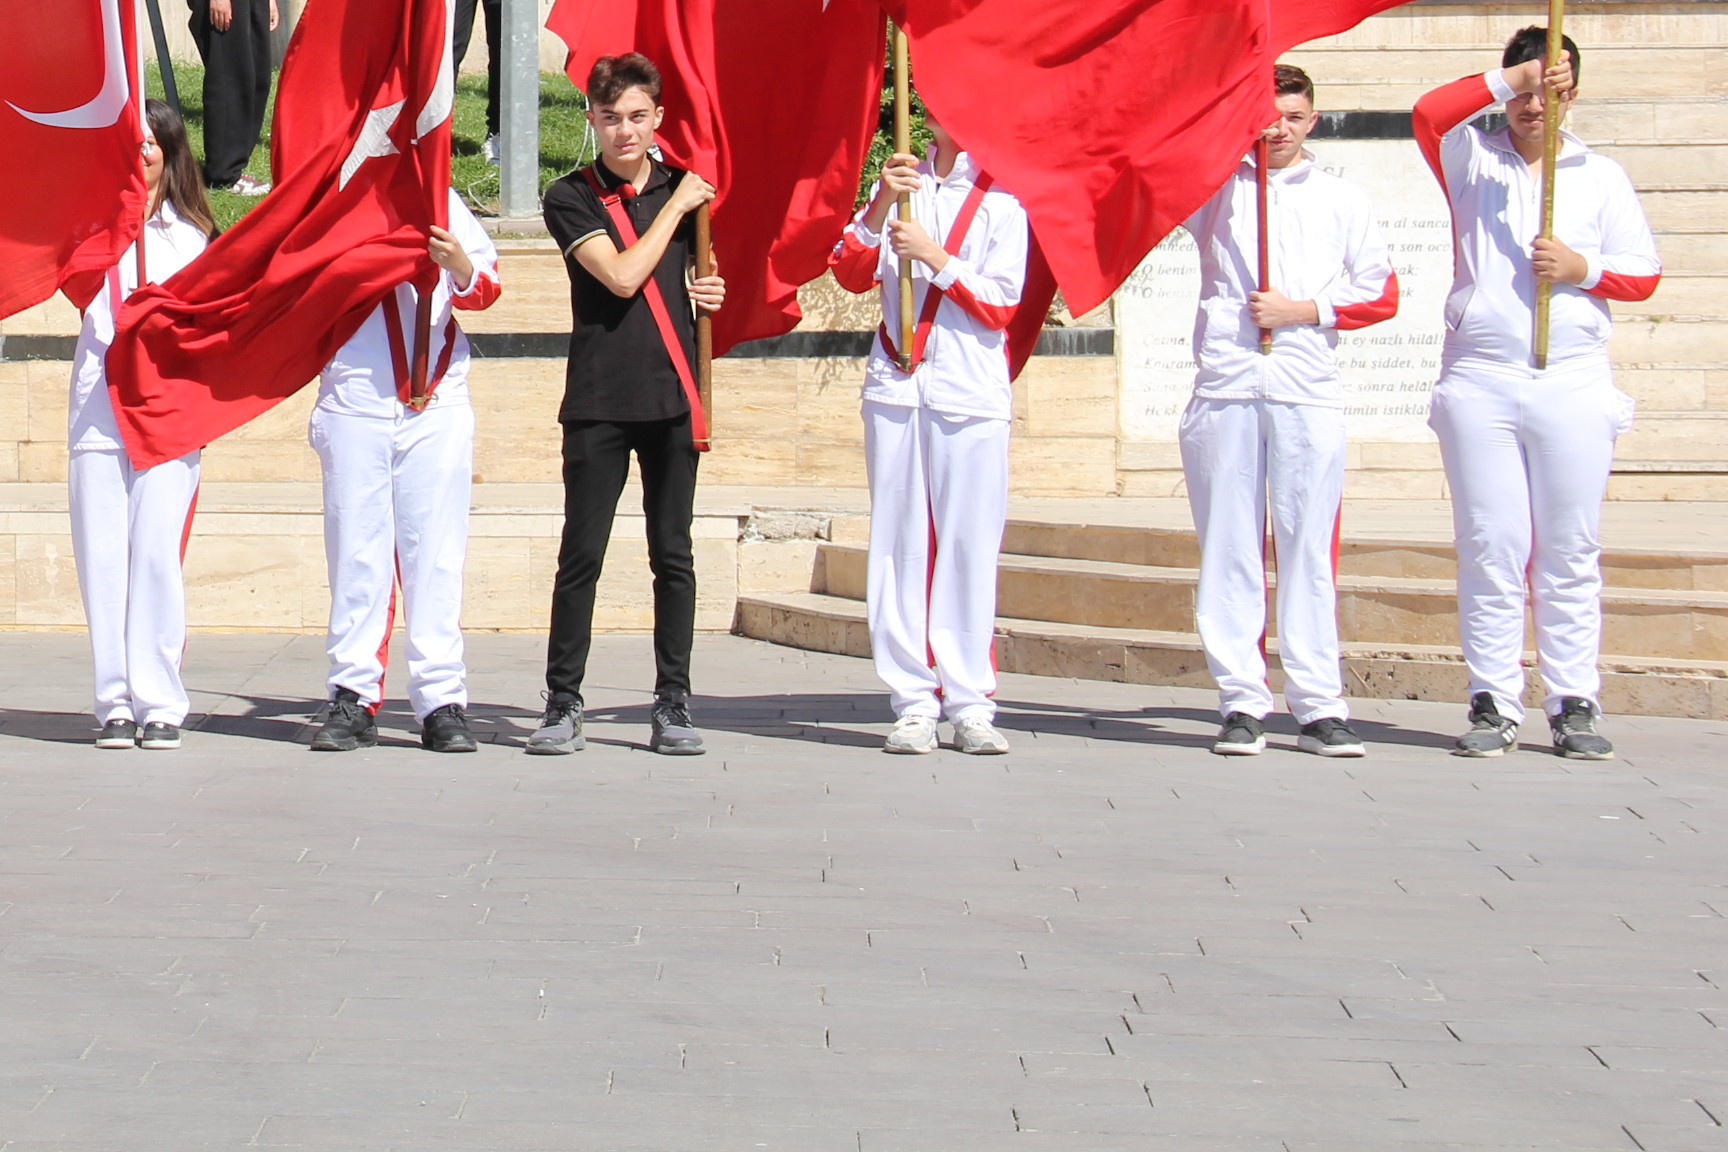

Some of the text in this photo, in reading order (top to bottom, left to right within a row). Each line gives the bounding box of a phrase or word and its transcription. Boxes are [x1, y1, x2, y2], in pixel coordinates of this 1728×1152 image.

[1400, 243, 1423, 252] son
[1142, 263, 1153, 275] O
[1142, 286, 1153, 299] O
[1352, 336, 1367, 348] ey
[1350, 357, 1366, 368] bu
[1421, 357, 1436, 368] bu
[1358, 383, 1394, 392] sonra
